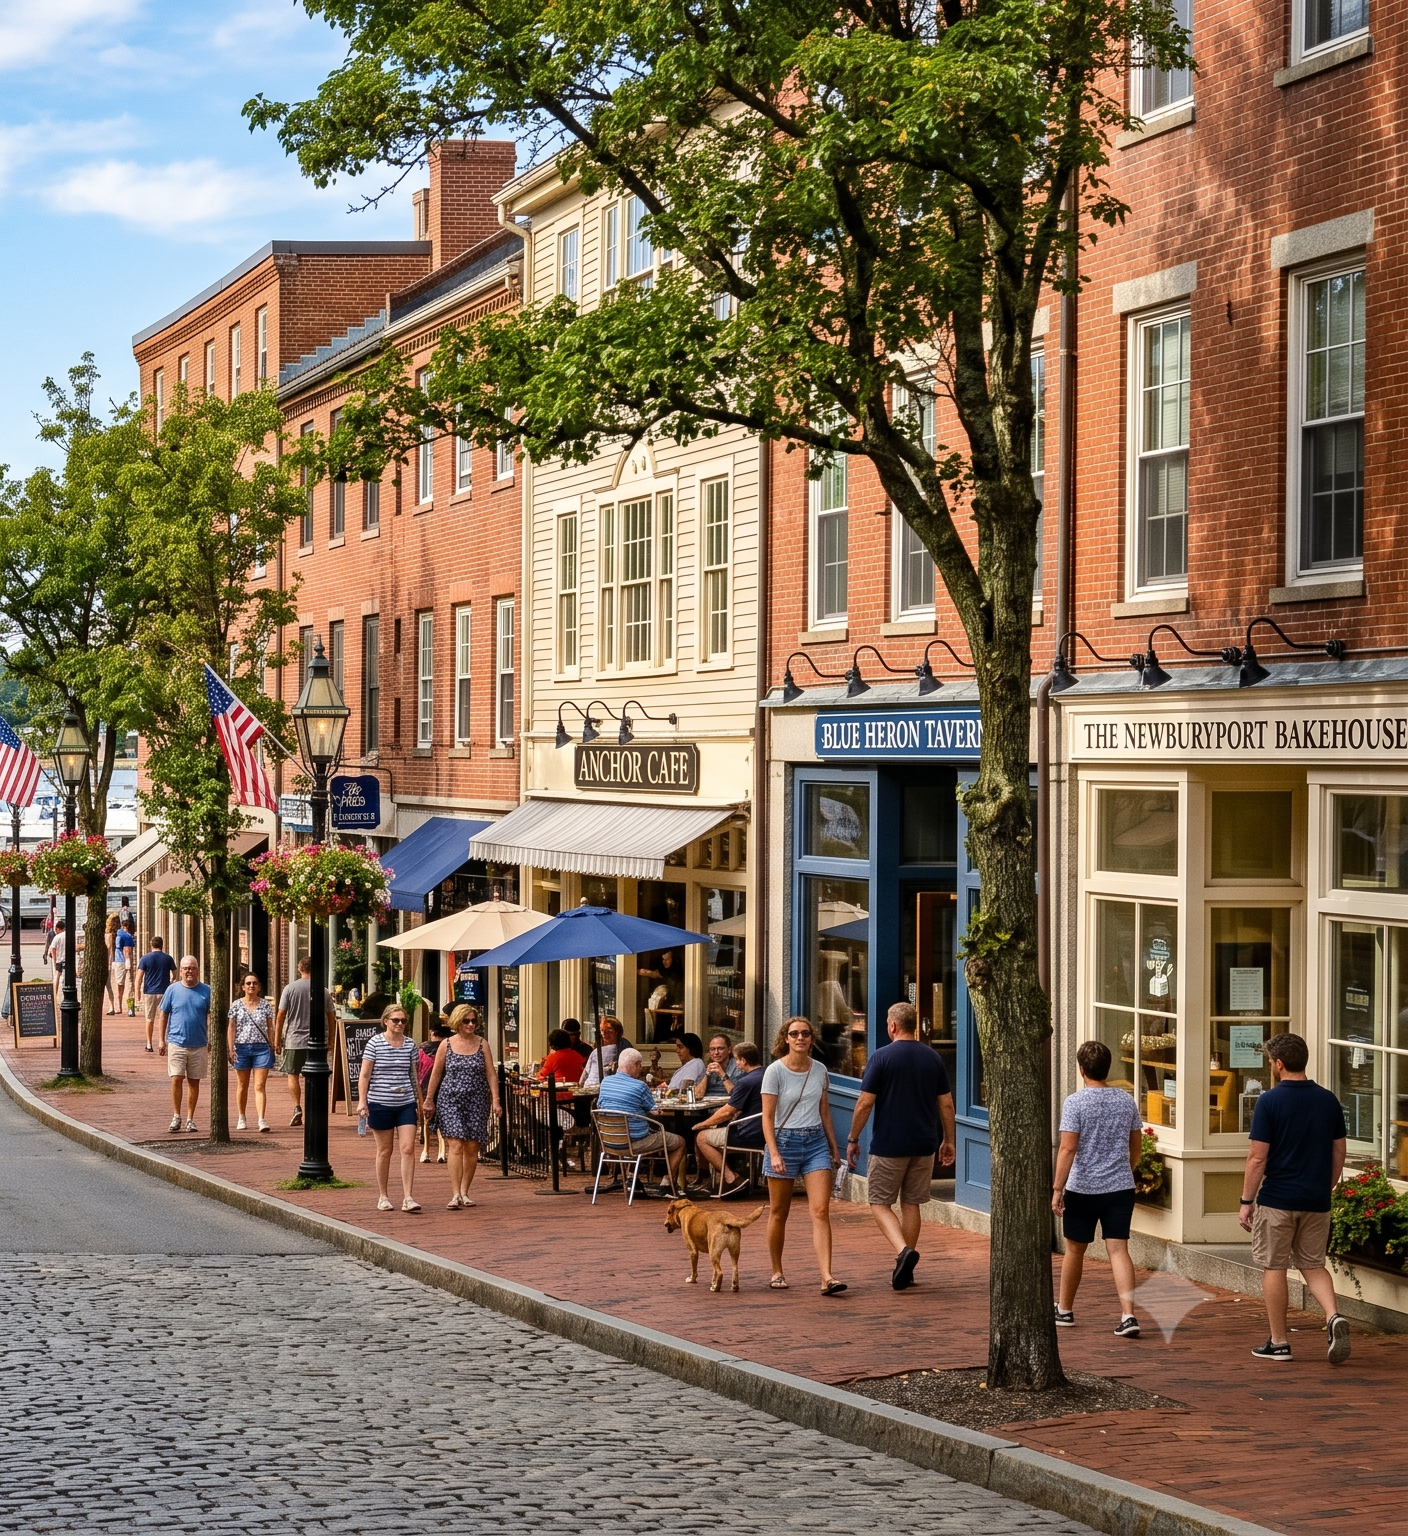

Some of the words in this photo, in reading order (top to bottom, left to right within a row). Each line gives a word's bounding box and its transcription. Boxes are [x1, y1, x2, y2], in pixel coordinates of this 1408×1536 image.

[821, 723, 861, 749] BLUE
[864, 720, 921, 749] HERON
[1083, 723, 1119, 749] THE
[1124, 720, 1268, 750] NEWBURYPORT
[1275, 718, 1408, 750] BAKEHOUSE
[578, 750, 643, 783] ANCHOR
[647, 751, 689, 785] CAFE
